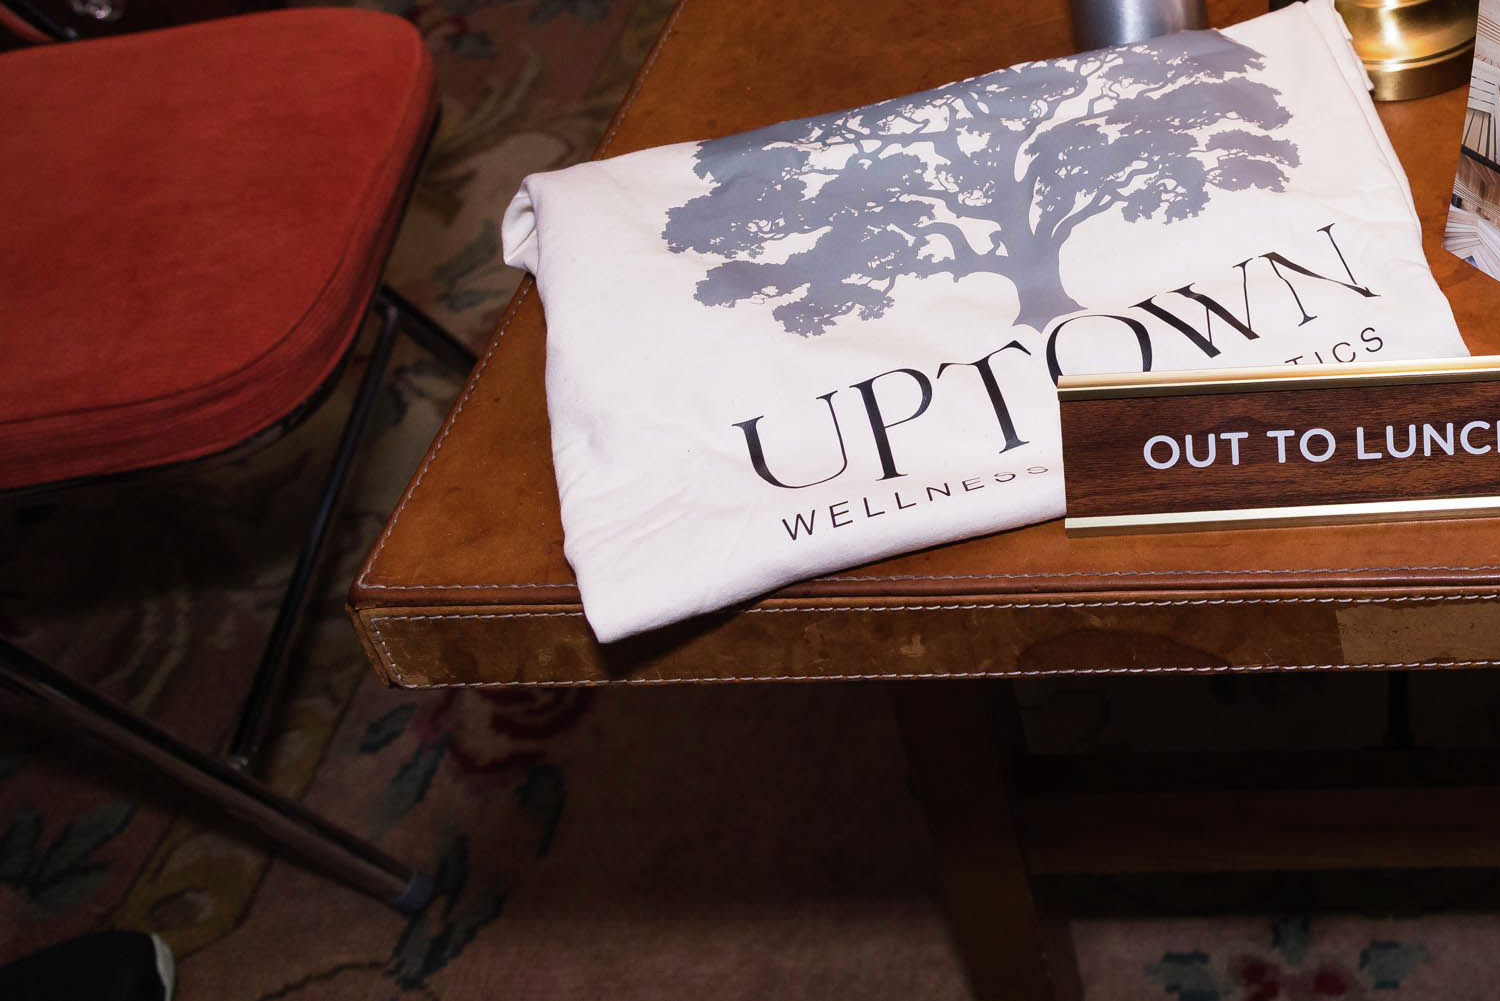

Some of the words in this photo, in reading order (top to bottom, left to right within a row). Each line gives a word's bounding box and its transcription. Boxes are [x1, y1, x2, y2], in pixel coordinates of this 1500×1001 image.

[732, 222, 1381, 488] UPTOWN
[1143, 431, 1249, 470] OUT
[1266, 427, 1336, 463] TO
[782, 465, 1048, 541] WELLNESS
